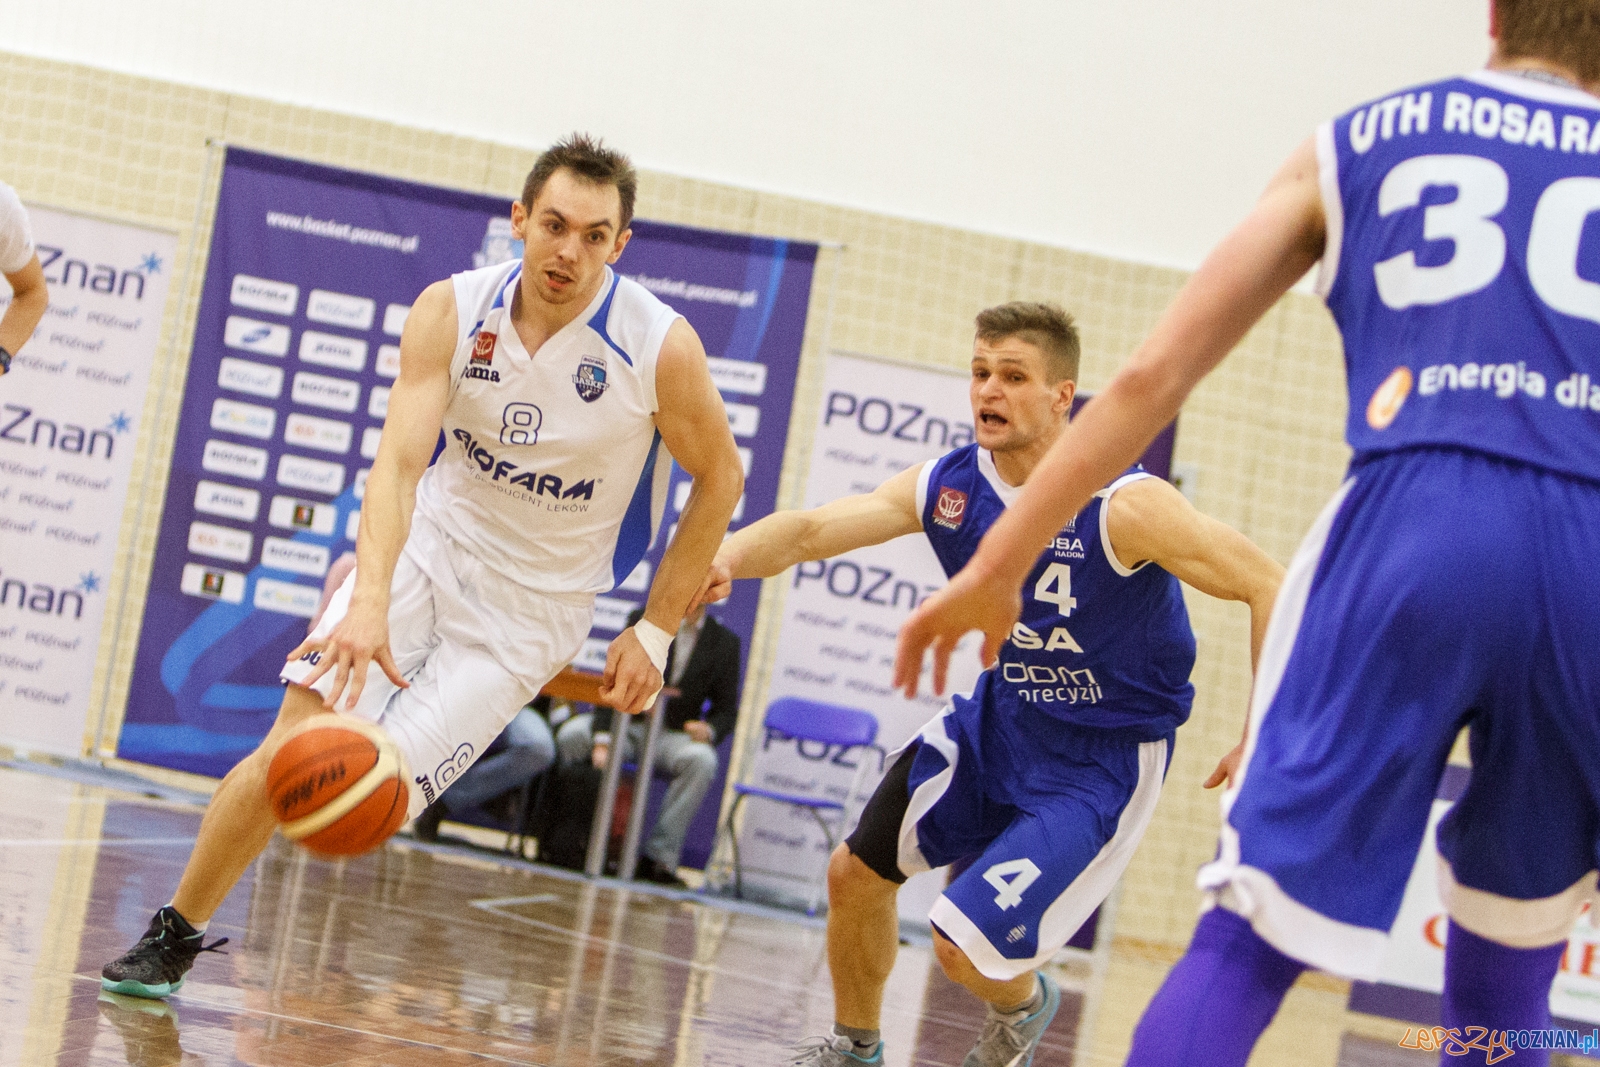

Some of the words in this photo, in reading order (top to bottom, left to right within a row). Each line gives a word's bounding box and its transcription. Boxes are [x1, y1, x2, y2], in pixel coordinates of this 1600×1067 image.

[1349, 90, 1432, 154] UTH
[1418, 362, 1547, 399] Energia
[500, 402, 543, 446] 8
[1054, 550, 1085, 560] RADOM
[1033, 562, 1077, 618] 4
[434, 742, 474, 791] 8
[982, 857, 1042, 912] 4
